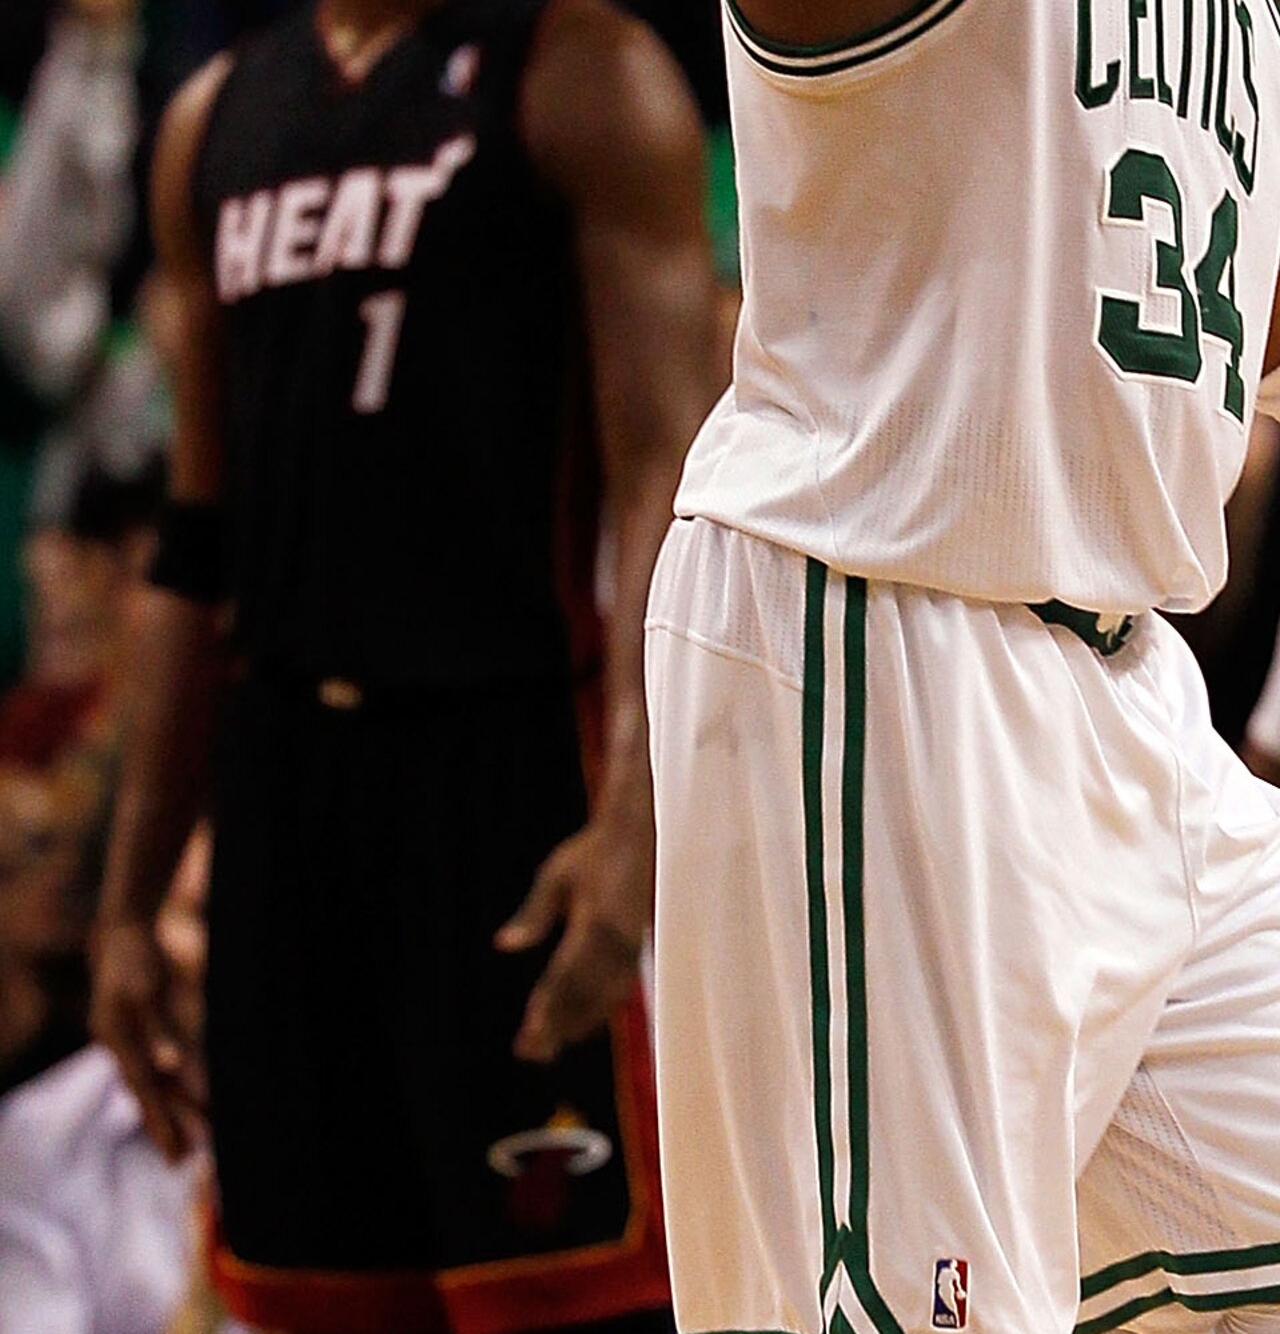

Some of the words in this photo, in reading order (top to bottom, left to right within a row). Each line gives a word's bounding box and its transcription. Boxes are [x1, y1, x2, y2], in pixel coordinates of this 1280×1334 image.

[214, 132, 477, 305] HEAT
[1096, 147, 1245, 425] 34
[350, 289, 407, 415] 1
